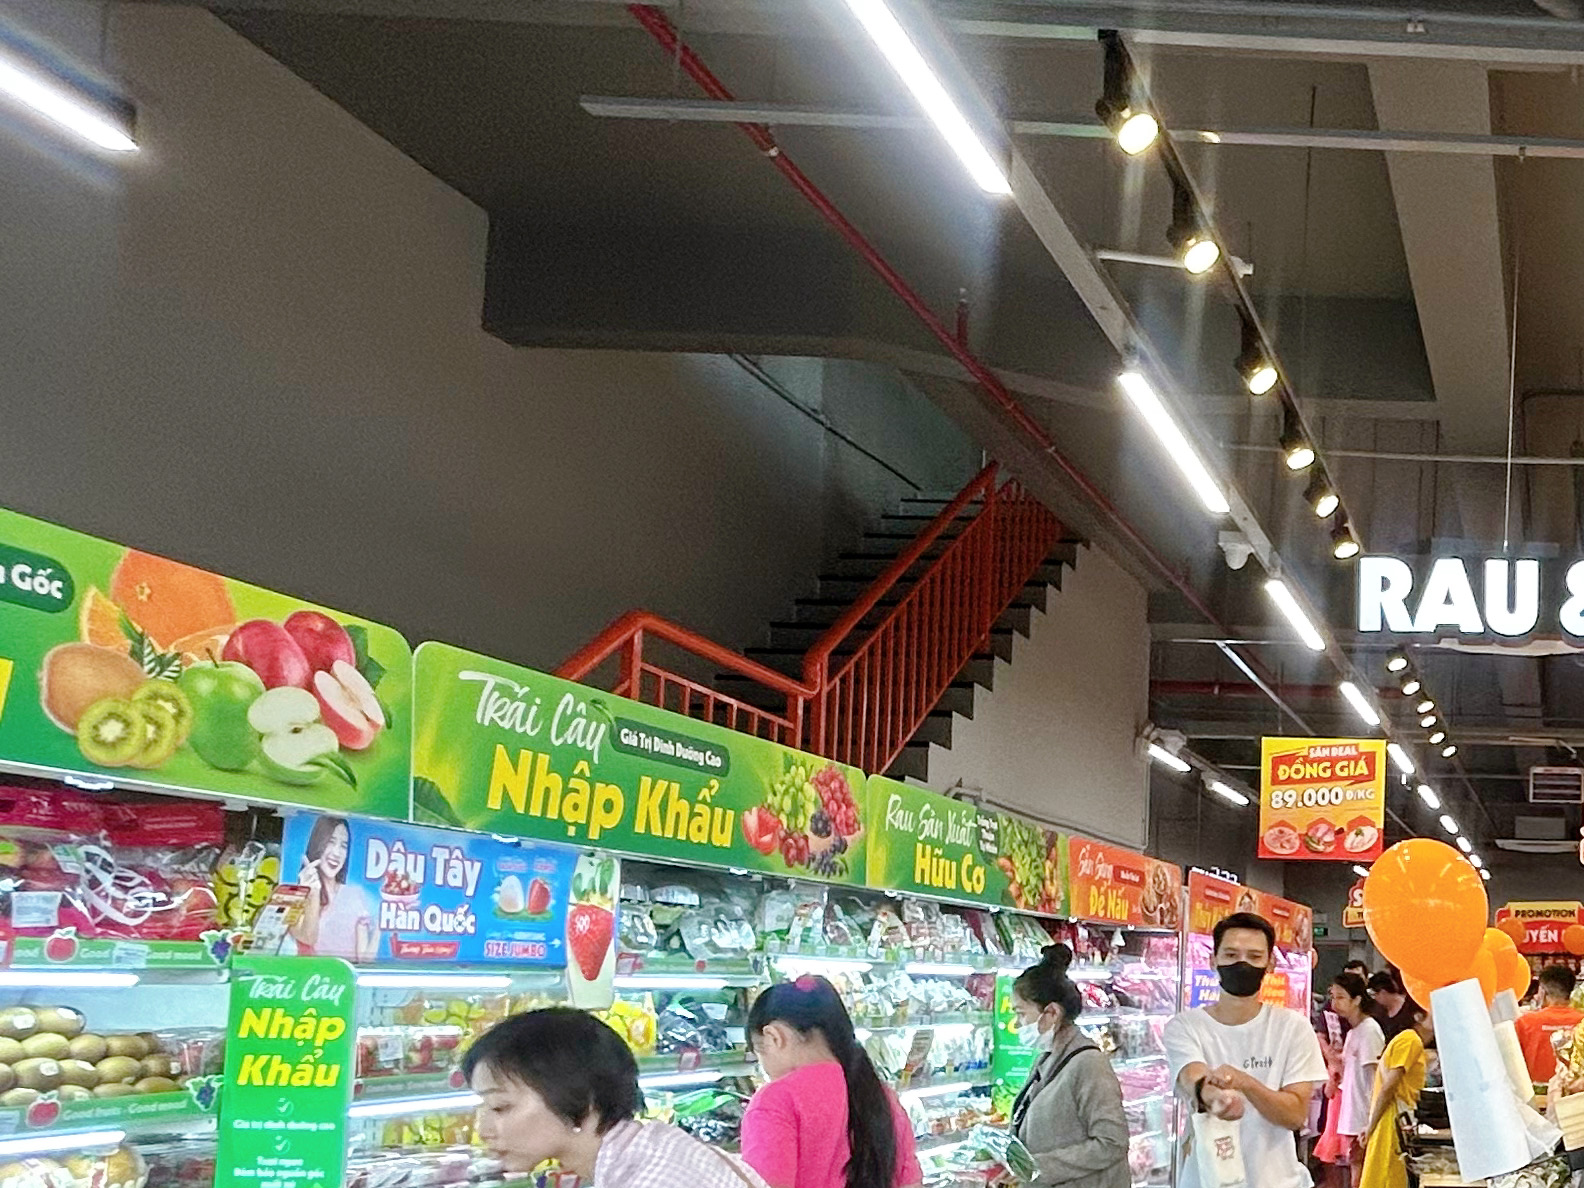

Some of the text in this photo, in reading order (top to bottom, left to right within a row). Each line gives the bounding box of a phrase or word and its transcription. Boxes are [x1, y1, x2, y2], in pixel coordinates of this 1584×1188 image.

[11, 563, 64, 599] Gốc
[1356, 555, 1541, 637] RAU
[459, 670, 607, 764] Trái Cây
[704, 750, 723, 768] Cao
[1277, 756, 1369, 780] ĐỒNG GIÁ
[1331, 745, 1358, 757] DEAL
[487, 744, 736, 848] Nhập Khẩu
[885, 793, 916, 832] Rau
[1271, 786, 1344, 809] 89.000
[365, 838, 483, 897] Dâu Tây
[914, 842, 985, 894] Hữu Cơ
[380, 903, 477, 935] Hàn Quốc
[1514, 909, 1576, 918] PROMOTION
[239, 974, 346, 1006] Trái Cây
[238, 1007, 346, 1047] Nhập
[237, 1049, 340, 1087] Khẩu
